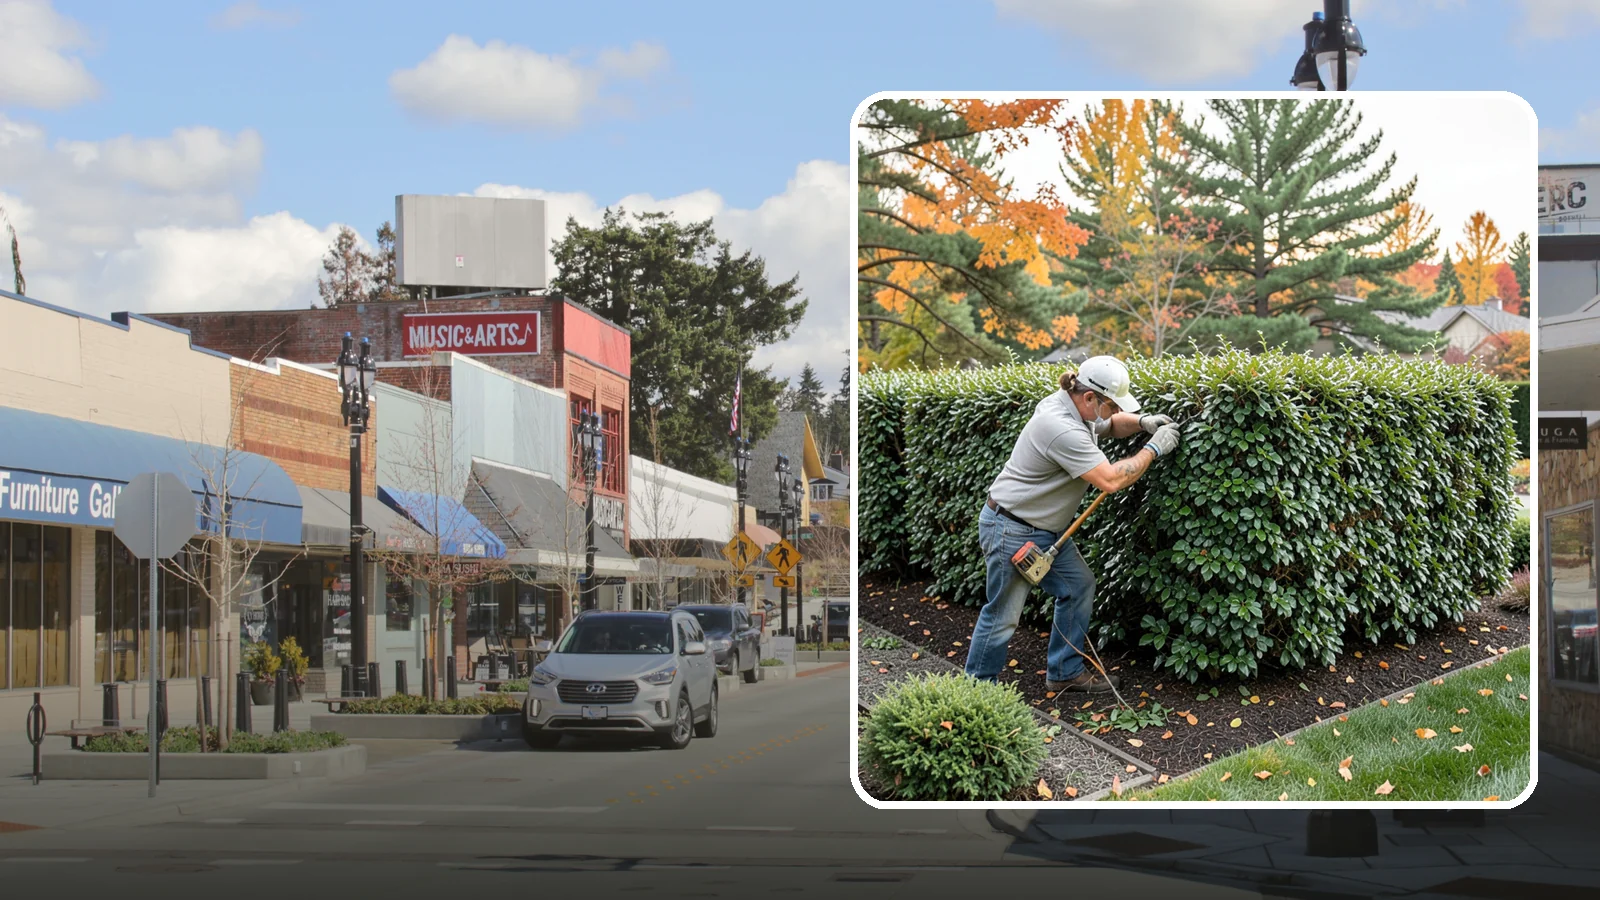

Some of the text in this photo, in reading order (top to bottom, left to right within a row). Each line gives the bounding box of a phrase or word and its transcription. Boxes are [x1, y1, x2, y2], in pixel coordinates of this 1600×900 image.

[1538, 181, 1587, 213] ERC
[1540, 427, 1577, 436] UGA
[0, 471, 122, 519] Furniture Gal
[453, 563, 479, 574] SUSHI
